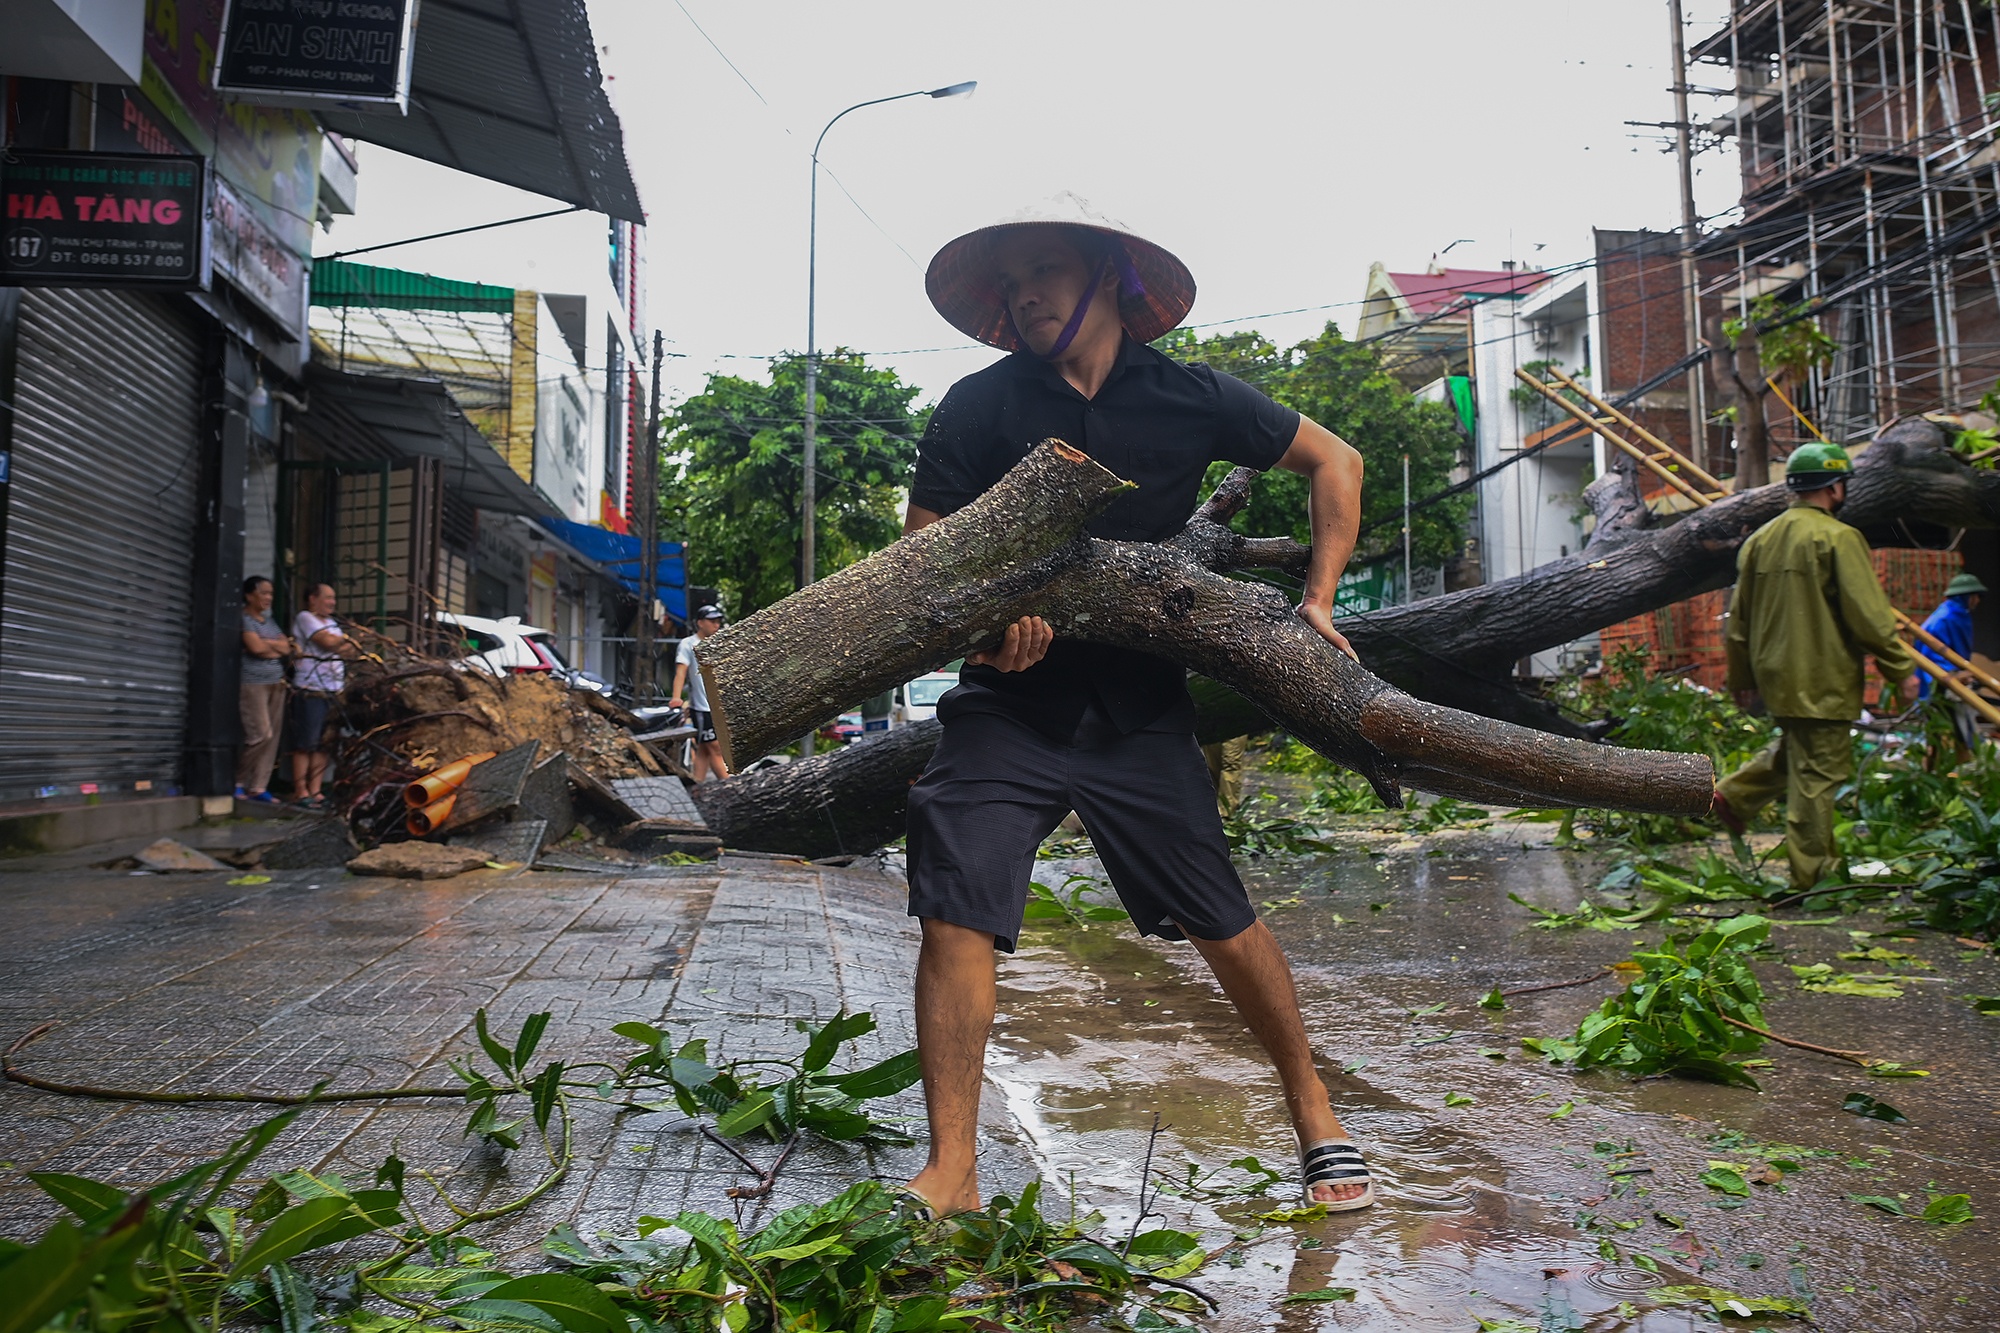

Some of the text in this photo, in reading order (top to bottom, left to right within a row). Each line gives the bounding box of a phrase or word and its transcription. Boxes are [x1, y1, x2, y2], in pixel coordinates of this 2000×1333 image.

[337, 3, 396, 21] KHOA
[233, 20, 395, 65] AN SINH
[245, 65, 268, 75] 167
[275, 67, 310, 77] PHAN
[311, 69, 338, 80] CHU
[339, 71, 375, 83] TRINH
[7, 190, 182, 225] HÀ TĂNG
[9, 237, 42, 258] 167
[51, 237, 80, 247] PHAN
[81, 237, 104, 248] CHU
[106, 238, 137, 249] TRINH
[50, 251, 184, 268] ĐT: 0968 537 800
